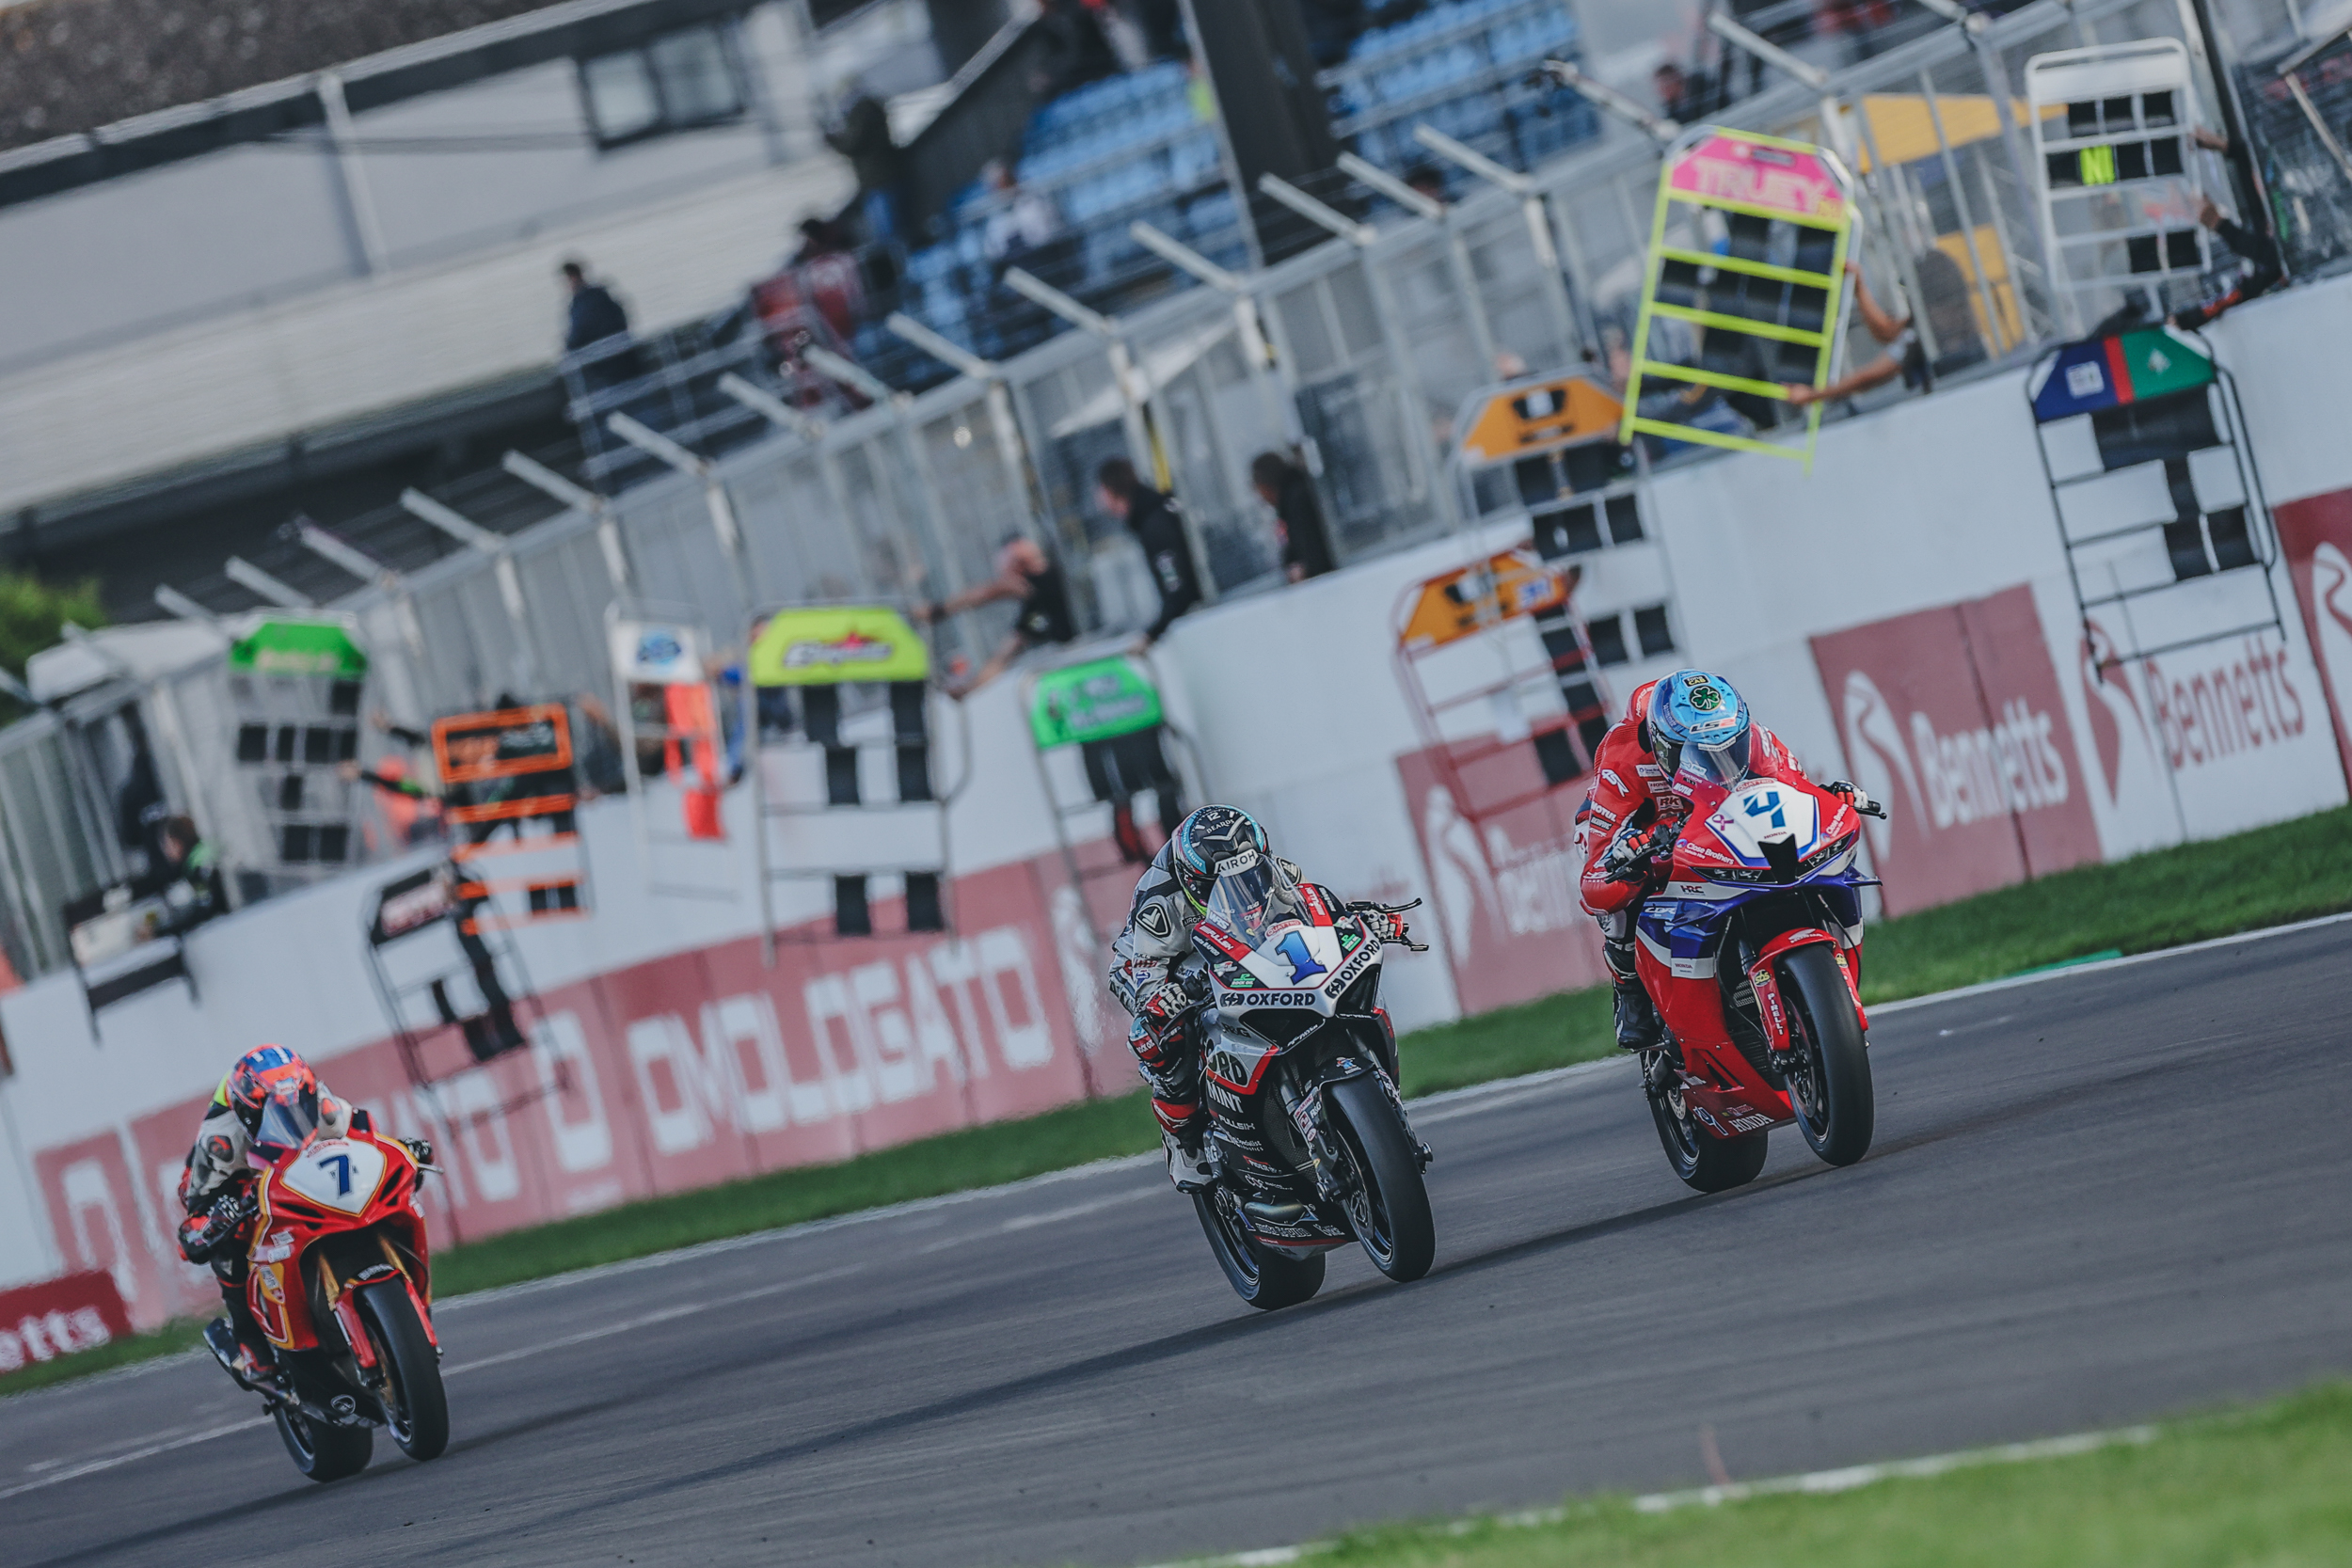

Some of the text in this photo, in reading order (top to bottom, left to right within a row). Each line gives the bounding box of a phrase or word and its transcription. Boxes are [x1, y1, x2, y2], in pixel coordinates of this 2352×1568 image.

[2140, 634, 2305, 769] Bennetts
[1691, 718, 1736, 733] LS2
[1911, 700, 2070, 830] Bennetts
[1736, 779, 1774, 792] QUATTRO
[1660, 798, 1680, 806] RK
[1764, 831, 1787, 840] HONDA
[1186, 848, 1204, 867] Hunt
[1216, 850, 1257, 874] AIROH
[1686, 842, 1735, 865] Close Brothers
[1680, 884, 1705, 894] HRC
[1266, 919, 1302, 937] QUATTRO
[1274, 929, 1328, 987] 1
[1340, 939, 1381, 982] OXFORD
[1246, 992, 1316, 1006] OXFORD
[1767, 992, 1784, 1036] PIRELLI
[627, 927, 1055, 1155] OMOLOGATO
[1207, 1081, 1244, 1114] MINT
[1218, 1114, 1256, 1131] FULLSIX
[1728, 1113, 1775, 1133] HONDA
[318, 1154, 353, 1199] 7
